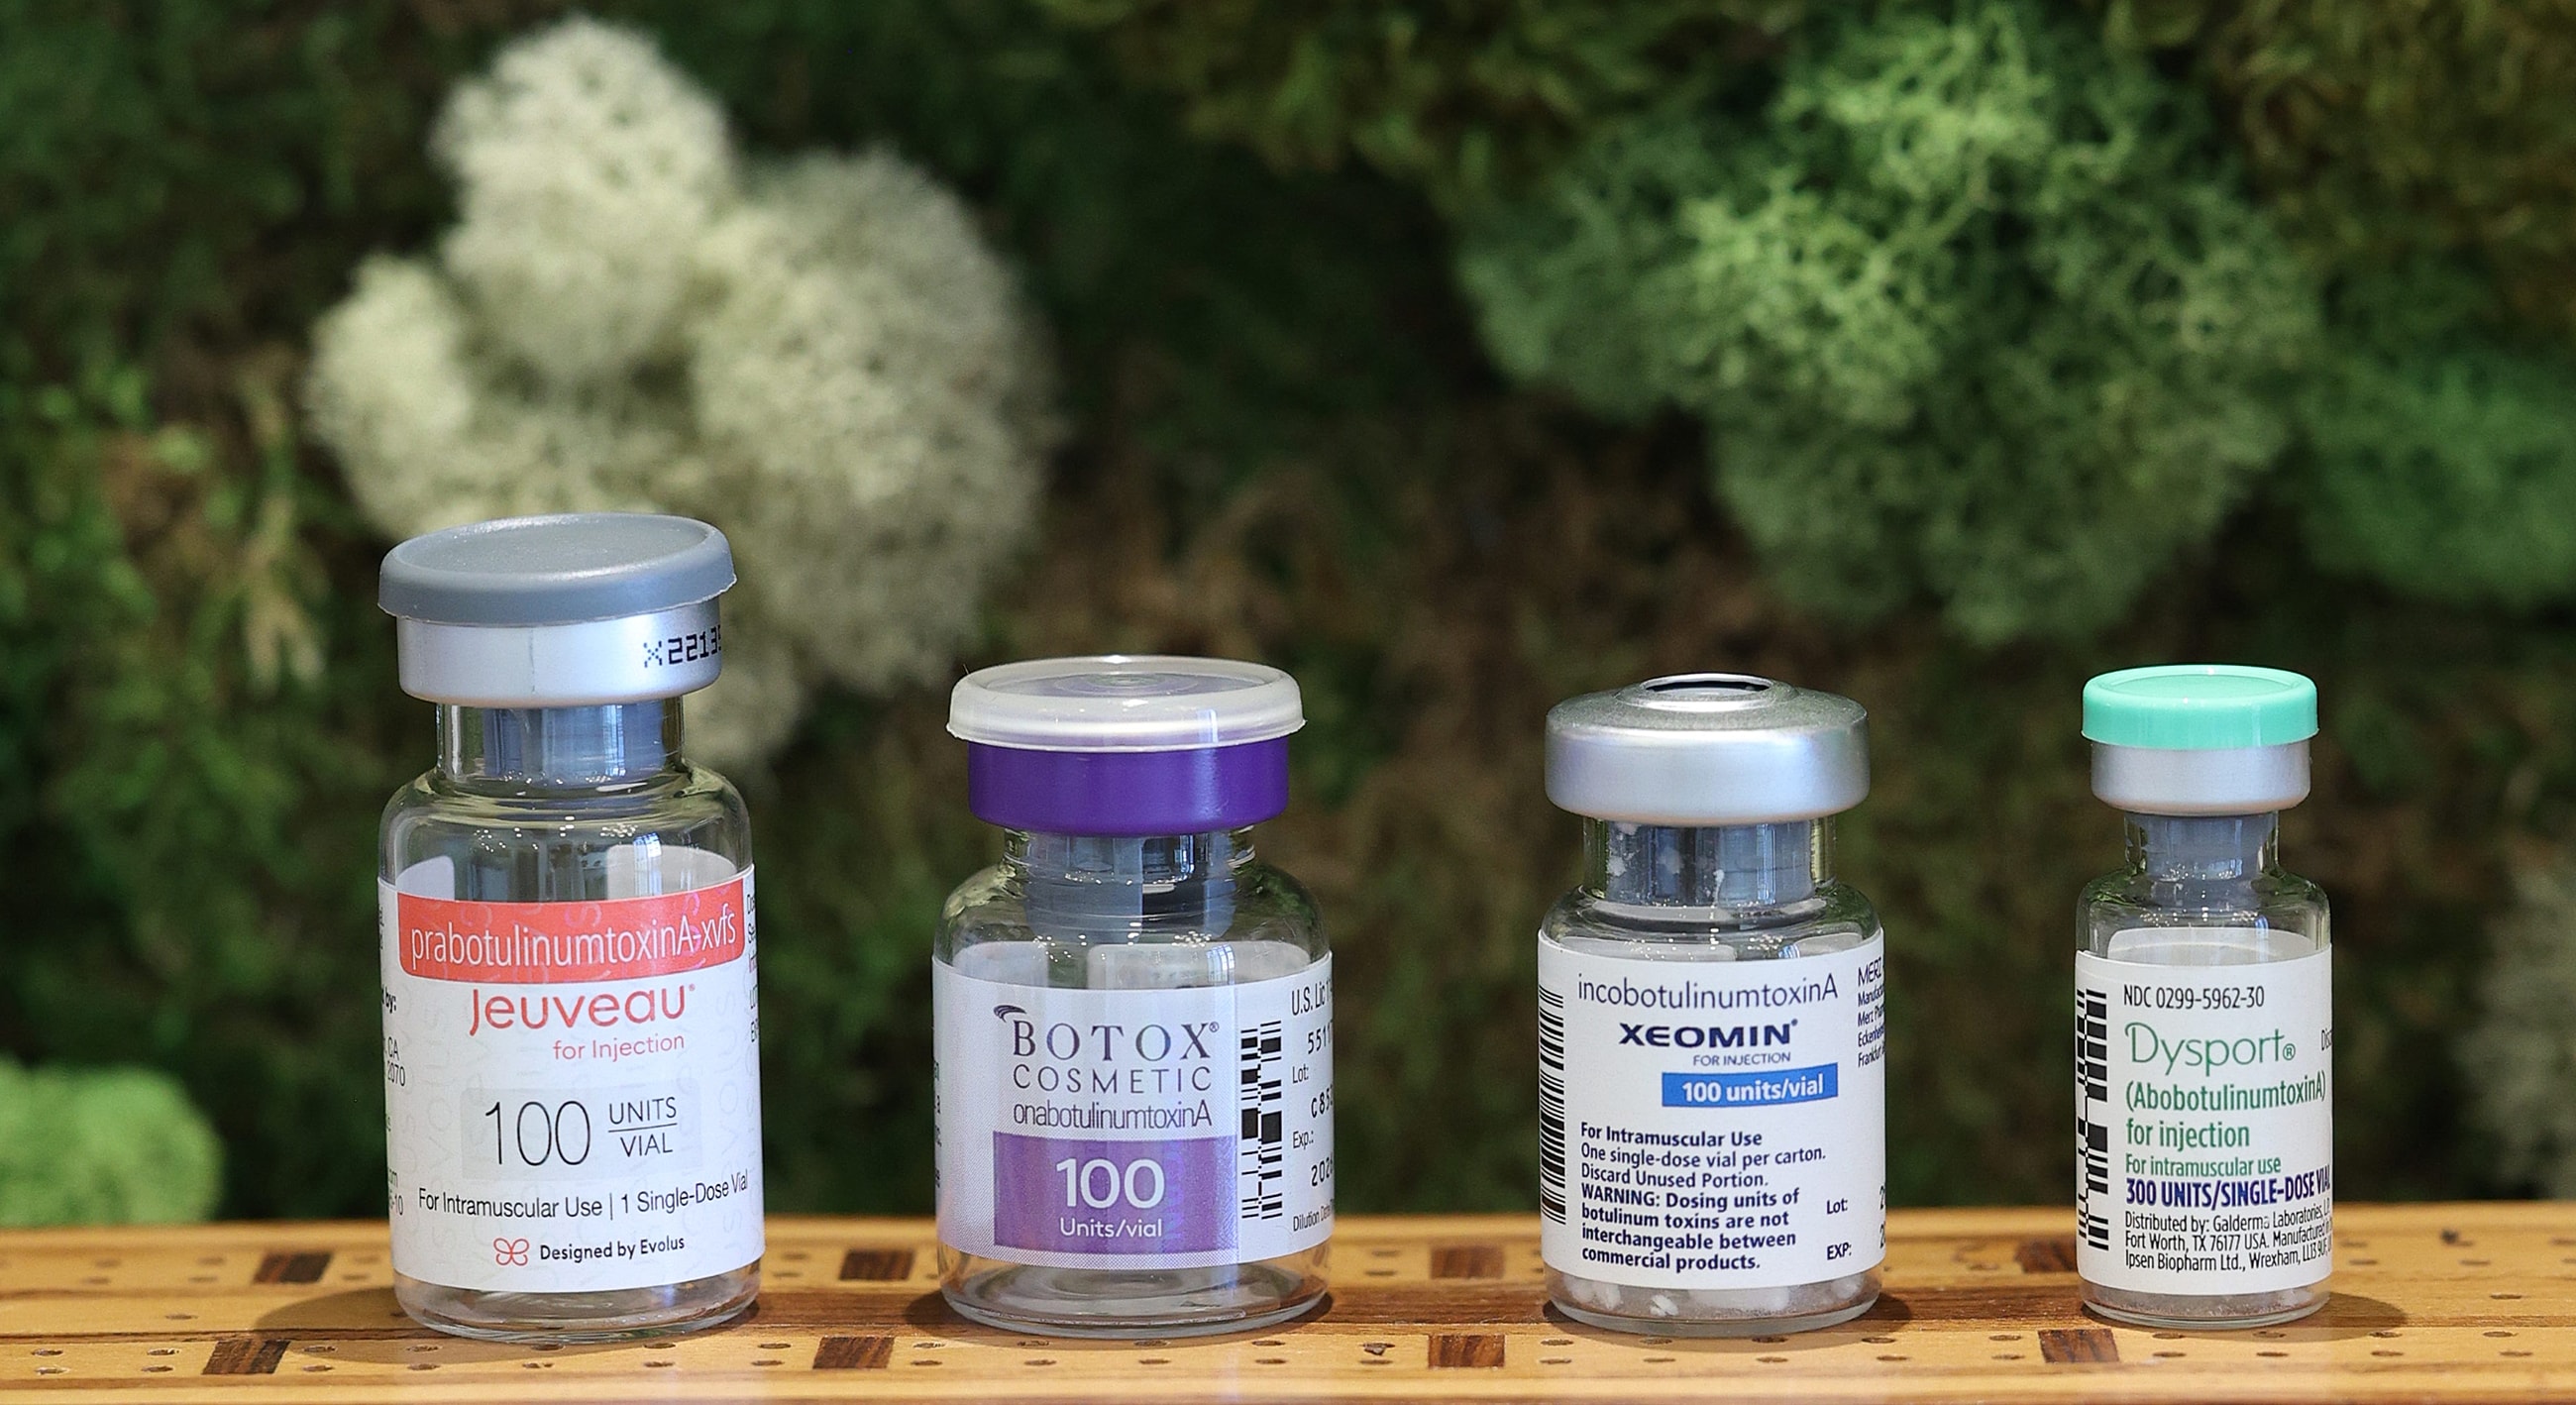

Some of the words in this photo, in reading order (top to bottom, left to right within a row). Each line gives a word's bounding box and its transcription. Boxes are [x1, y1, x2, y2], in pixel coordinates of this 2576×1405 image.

[410, 903, 736, 970] prabotulinumtoxinA-xvfs
[1858, 957, 1881, 987] MERZ
[1291, 986, 1314, 1016] U.S.
[1578, 973, 1839, 1010] incobotulinumtoxinA
[2124, 984, 2152, 1009] NDC
[2156, 985, 2265, 1010] 0299-5962-30
[1858, 1011, 1875, 1027] Merz
[553, 1040, 583, 1060] for
[592, 1033, 685, 1061] Injection
[1692, 1055, 1720, 1067] FOR
[1723, 1052, 1791, 1066] INJECTION
[1013, 1063, 1212, 1095] COSMETIC
[1292, 1063, 1309, 1084] Lot:
[1682, 1081, 1721, 1103] 100
[1726, 1073, 1823, 1101] units/vial
[2125, 1069, 2326, 1112] (AbobotulinumtoxinA)
[608, 1096, 678, 1126] UNITS
[1014, 1099, 1213, 1130] onabotulinumtoxinA
[485, 1101, 591, 1166] 100
[619, 1132, 674, 1158] VIAL
[1580, 1122, 1602, 1140] For
[1606, 1126, 1726, 1147] Intramuscular
[1731, 1132, 1763, 1146] Use
[2126, 1118, 2153, 1146] for
[2159, 1121, 2250, 1152] injection
[1581, 1142, 1606, 1161] One
[1610, 1146, 1701, 1170] single-dose
[1706, 1150, 1736, 1168] vial
[1743, 1154, 1770, 1175] per
[1775, 1146, 1827, 1165] carton.
[2125, 1153, 2146, 1174] For
[2150, 1155, 2254, 1177] intramuscular
[2258, 1157, 2282, 1174] use
[1055, 1157, 1166, 1209] 100
[1581, 1162, 1631, 1185] Discard
[1636, 1170, 1695, 1188] Unused
[1702, 1171, 1769, 1189] Portion.
[418, 1186, 439, 1211] For
[442, 1190, 558, 1219] Intramuscular
[565, 1196, 602, 1218] Use
[621, 1193, 629, 1214] 1
[637, 1180, 729, 1216] Single-Dose
[731, 1168, 749, 1195] Vial
[1581, 1183, 1661, 1209] WARNING:
[1665, 1191, 1728, 1215] Dosing
[1733, 1190, 1778, 1208] units
[1782, 1187, 1800, 1205] of
[2126, 1178, 2157, 1206] 300
[2161, 1171, 2314, 1210] UNITS/SINGLE-DOSE
[1581, 1203, 1660, 1229] botulinum
[1664, 1213, 1720, 1231] toxins
[1726, 1216, 1754, 1229] are
[1760, 1211, 1789, 1228] not
[1826, 1198, 1848, 1215] Lot:
[1059, 1218, 1163, 1238] Units/vial
[1293, 1211, 1320, 1232] Dilution
[2125, 1211, 2188, 1232] Distributed
[2191, 1214, 2210, 1233] by:
[2213, 1215, 2271, 1232] Galderma
[539, 1241, 612, 1261] Designed
[616, 1241, 636, 1260] by
[640, 1235, 686, 1255] Evolus
[1581, 1223, 1713, 1252] interchangeable
[1719, 1232, 1796, 1250] between
[1826, 1242, 1852, 1260] EXP:
[2125, 1234, 2147, 1248] Fort
[2149, 1235, 2190, 1252] Worth,
[2193, 1237, 2206, 1251] TX
[2210, 1235, 2241, 1250] 76177
[2244, 1232, 2270, 1249] USA.
[1581, 1246, 1670, 1270] commercial
[1676, 1253, 1761, 1274] products.
[2125, 1249, 2155, 1270] Ipsen
[2158, 1252, 2216, 1273] Biopharm
[2220, 1252, 2246, 1271] Ltd.,
[2249, 1249, 2301, 1269] Wrexham,
[2303, 1243, 2316, 1261] LL13
